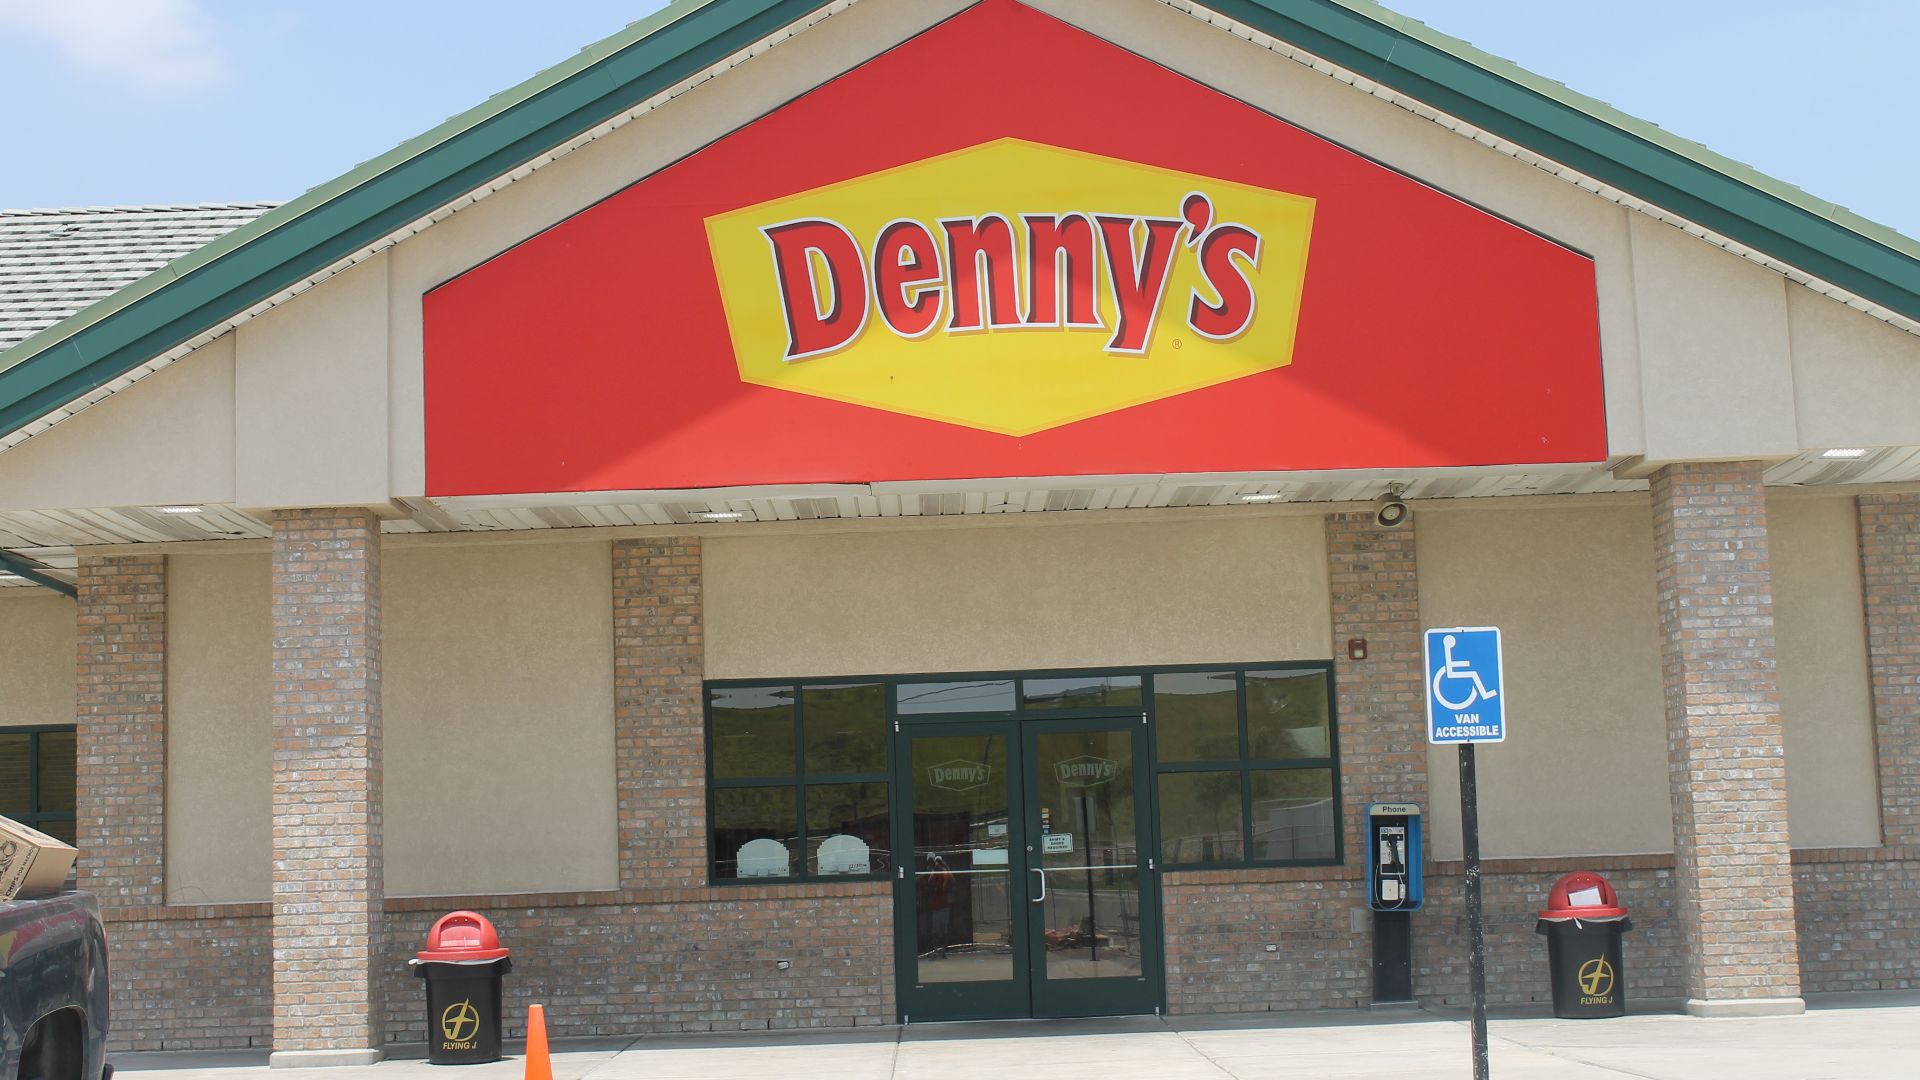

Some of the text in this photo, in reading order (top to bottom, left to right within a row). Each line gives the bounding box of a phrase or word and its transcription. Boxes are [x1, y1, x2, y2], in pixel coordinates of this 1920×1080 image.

[757, 190, 1263, 361] Denny's
[1454, 713, 1480, 724] VAN
[1435, 725, 1499, 738] ACCESSIBLE
[933, 765, 985, 784] Denny's
[1060, 760, 1110, 779] Denny's
[1382, 805, 1406, 813] Phone
[5, 876, 19, 897] CHIPS
[1580, 995, 1613, 1005] FLYING J
[442, 1041, 477, 1050] FLYING J
